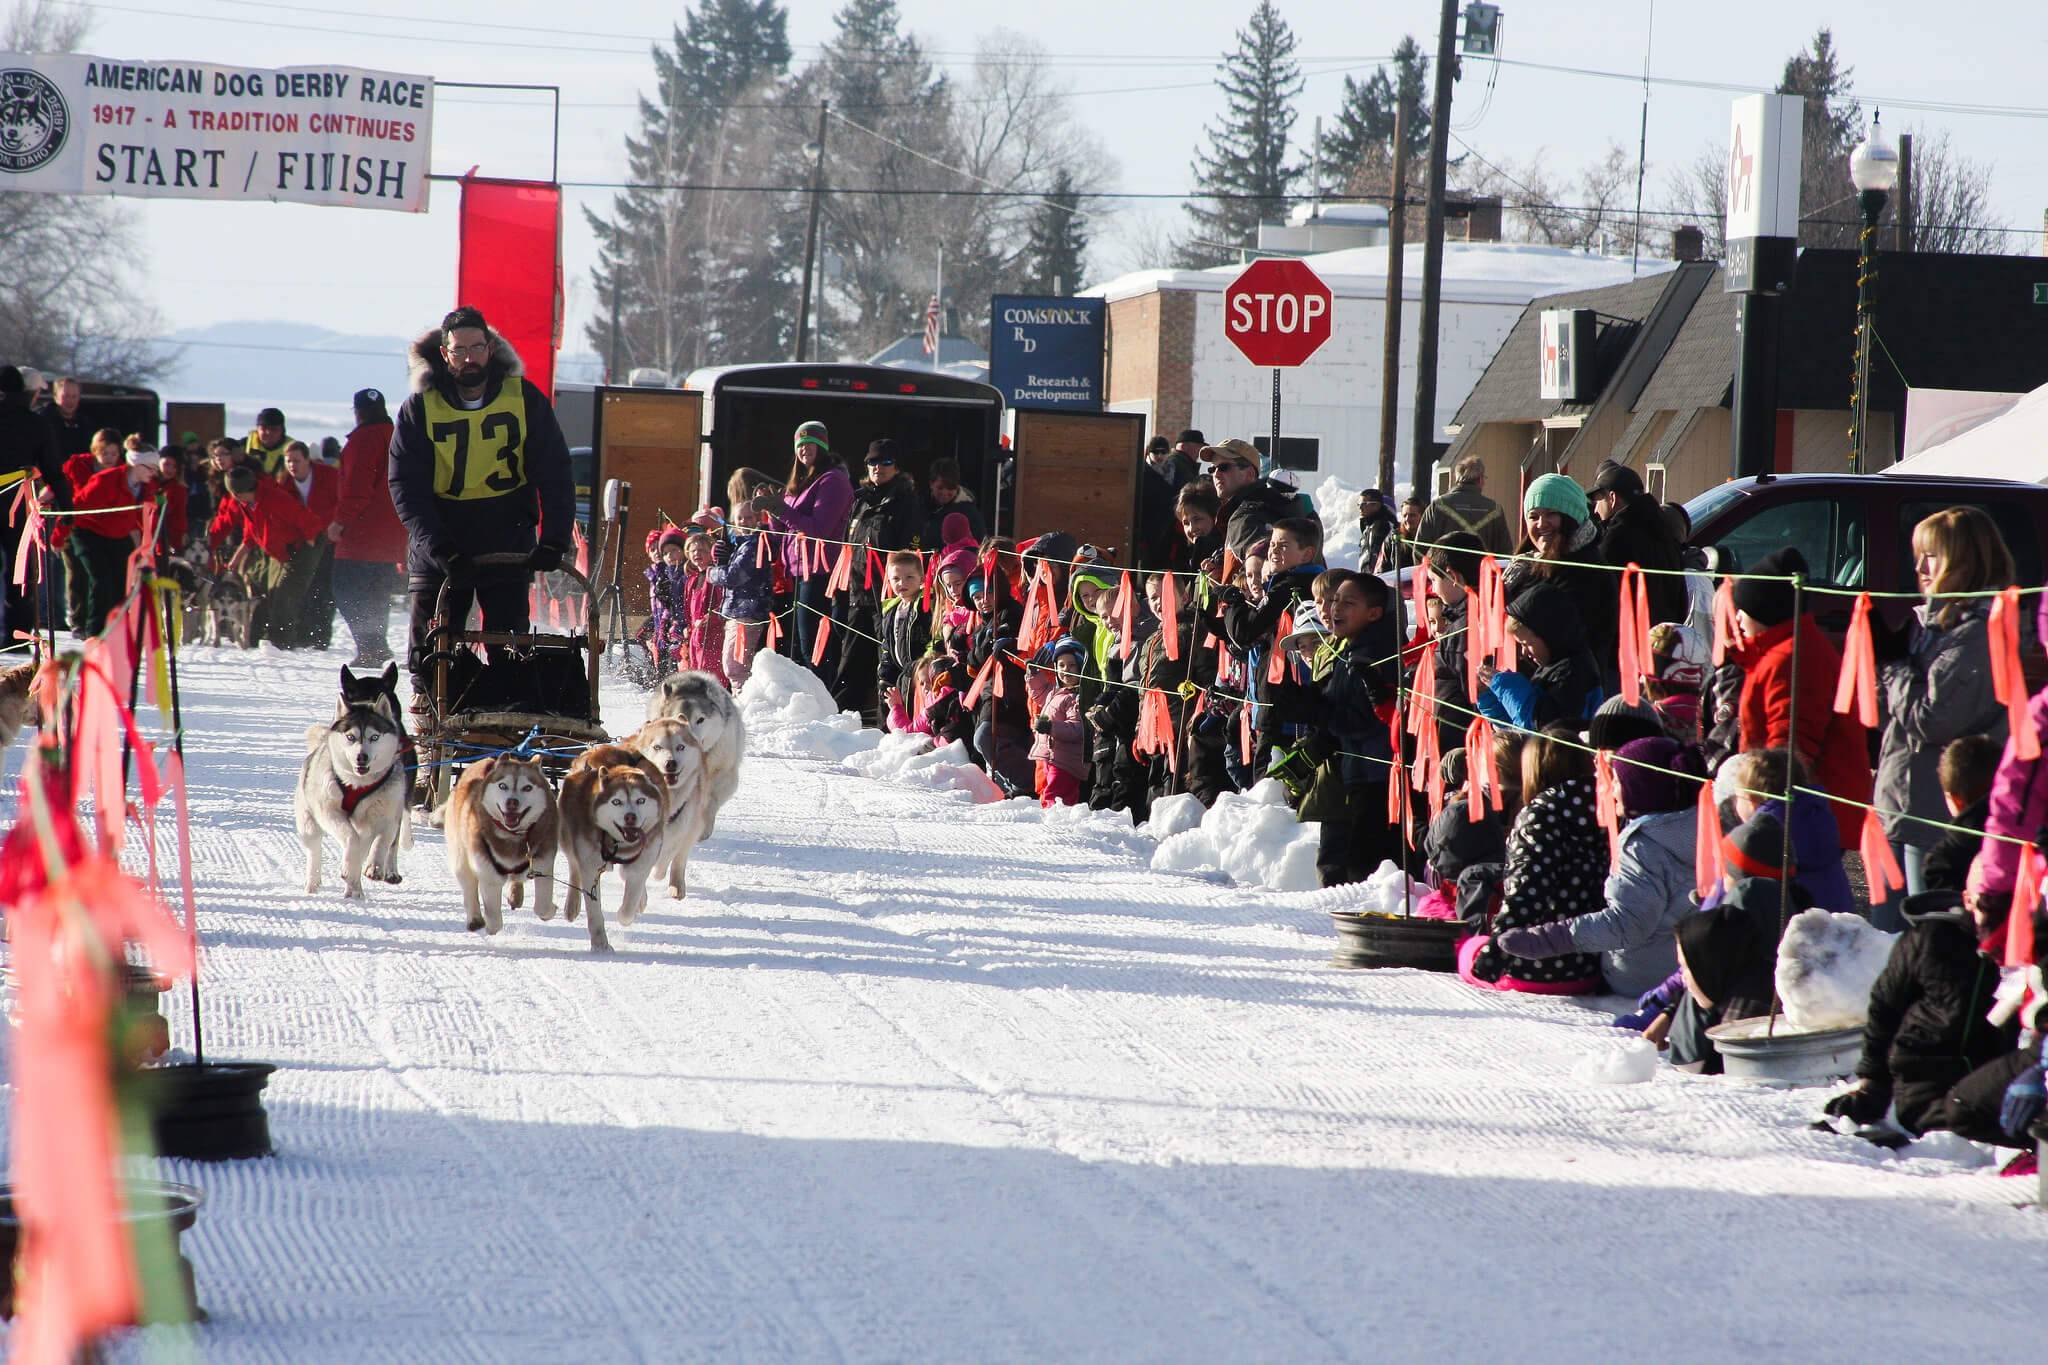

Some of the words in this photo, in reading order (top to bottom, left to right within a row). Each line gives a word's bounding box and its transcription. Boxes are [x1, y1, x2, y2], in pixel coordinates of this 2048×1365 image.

[85, 62, 203, 94] AMERICAN
[214, 71, 264, 97] DOG
[275, 73, 349, 98] DERBY
[360, 77, 425, 109] RACE
[47, 95, 64, 134] DERBY
[93, 103, 136, 126] 1917
[164, 109, 177, 129] A
[188, 110, 298, 133] TRADITION
[17, 148, 49, 167] IDAHO
[96, 143, 225, 188] START
[1004, 308, 1092, 325] COMSTOCK
[1231, 293, 1326, 333] STOP
[1014, 389, 1090, 402] Development
[1028, 375, 1078, 387] Research
[1080, 377, 1091, 387] &
[432, 411, 521, 497] 73
